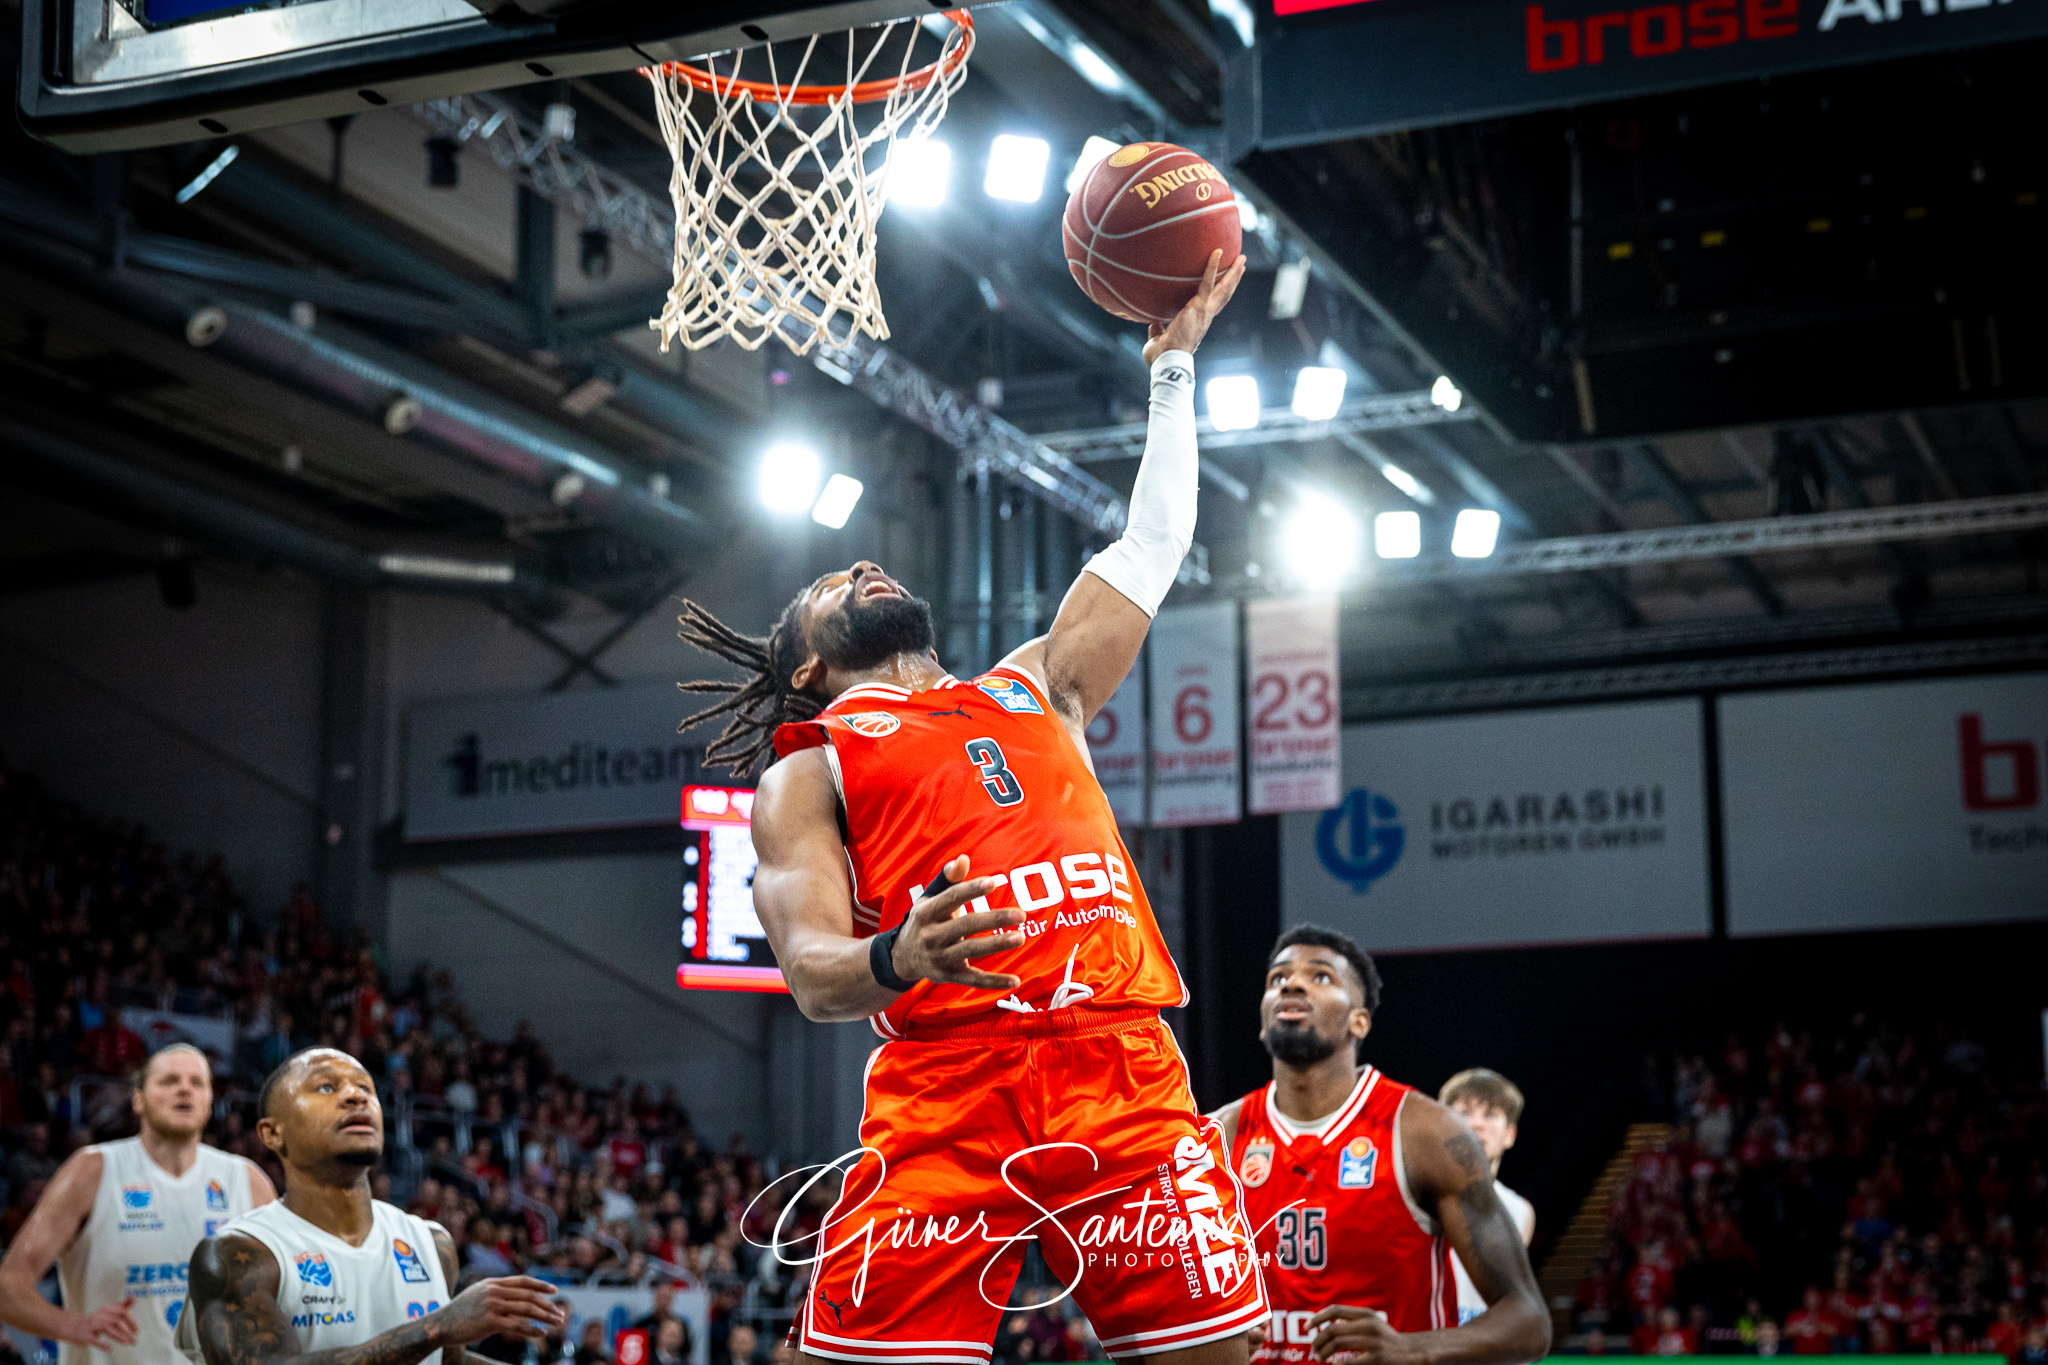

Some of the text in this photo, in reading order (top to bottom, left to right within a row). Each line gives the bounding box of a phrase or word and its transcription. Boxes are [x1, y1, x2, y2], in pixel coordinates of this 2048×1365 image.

[1526, 0, 1799, 73] brose
[1134, 162, 1229, 209] PALDING
[1173, 684, 1214, 745] 6
[1255, 669, 1332, 731] 23
[965, 736, 1025, 807] 3
[1430, 784, 1664, 832] IGARASHI
[909, 852, 1133, 917] rose
[1275, 1206, 1327, 1271] 35
